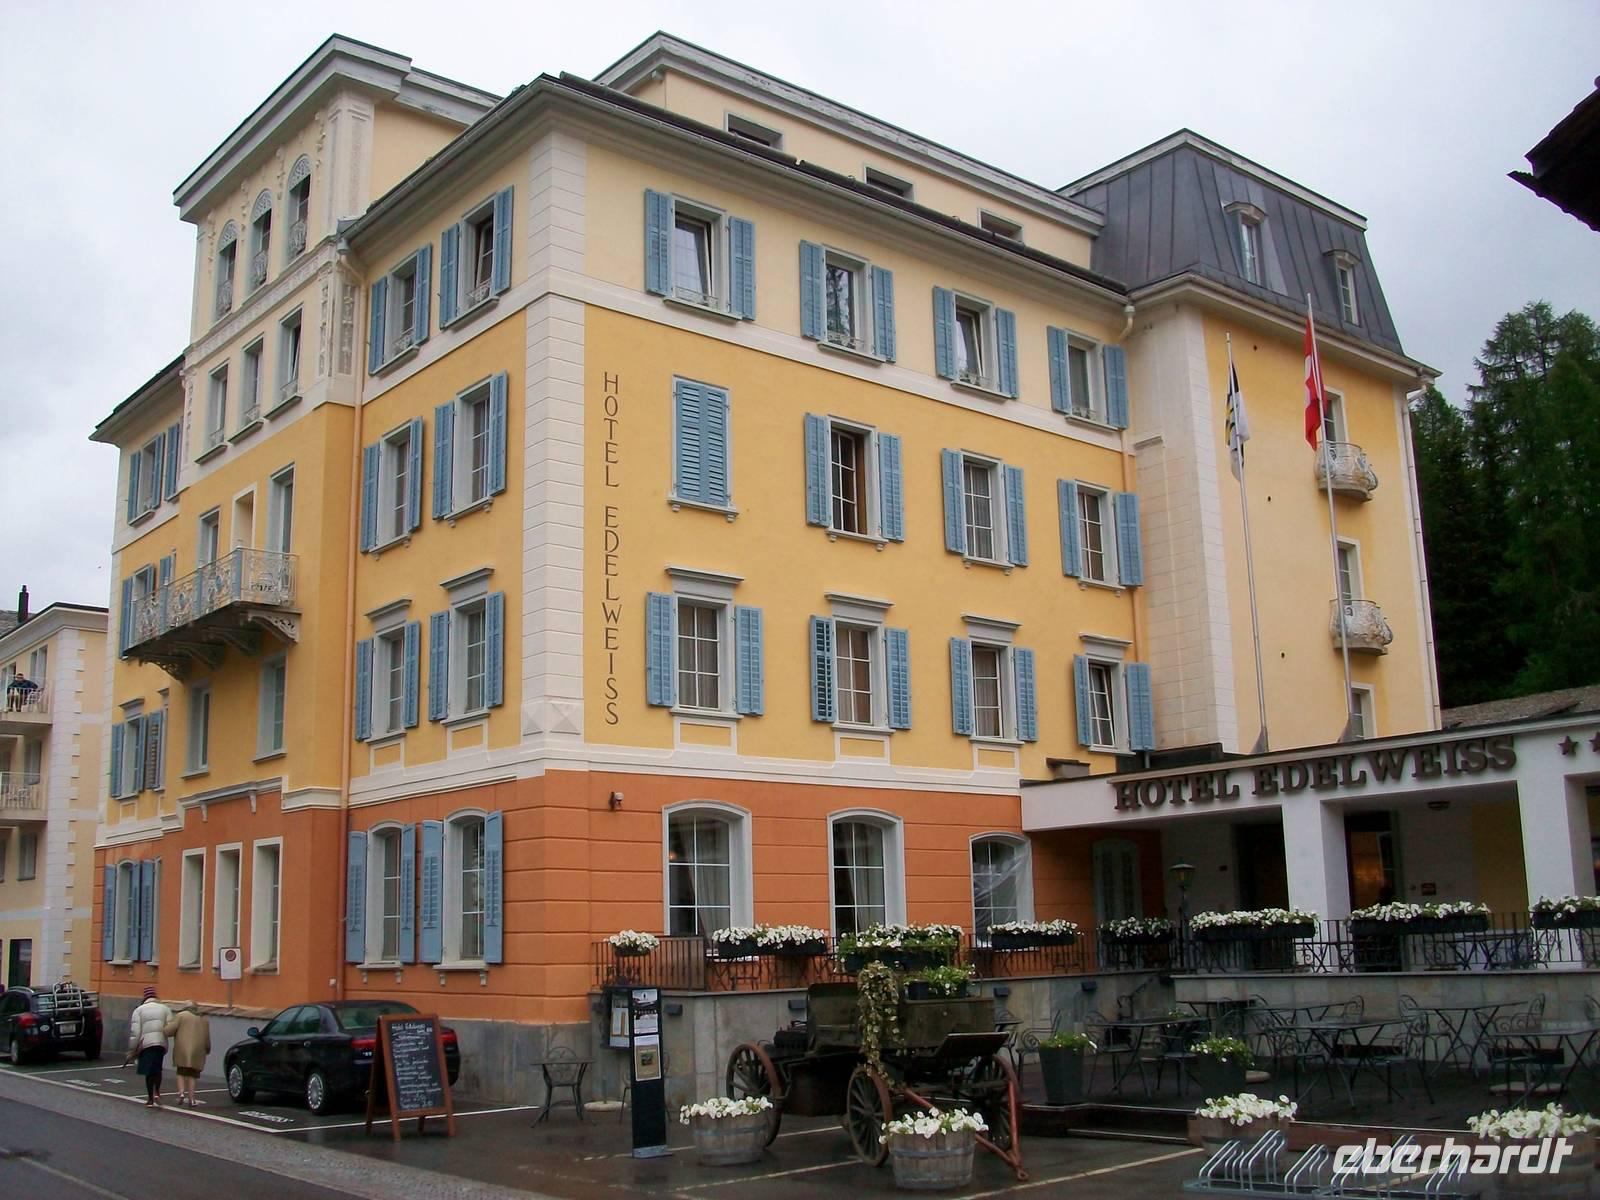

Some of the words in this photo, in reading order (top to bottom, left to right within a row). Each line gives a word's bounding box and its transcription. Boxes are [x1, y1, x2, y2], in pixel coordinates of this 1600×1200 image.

[603, 371, 619, 487] HOTEL
[602, 506, 622, 725] EDELWEISS
[1114, 771, 1239, 810] HOTEL
[1252, 737, 1517, 796] EDELWEISS
